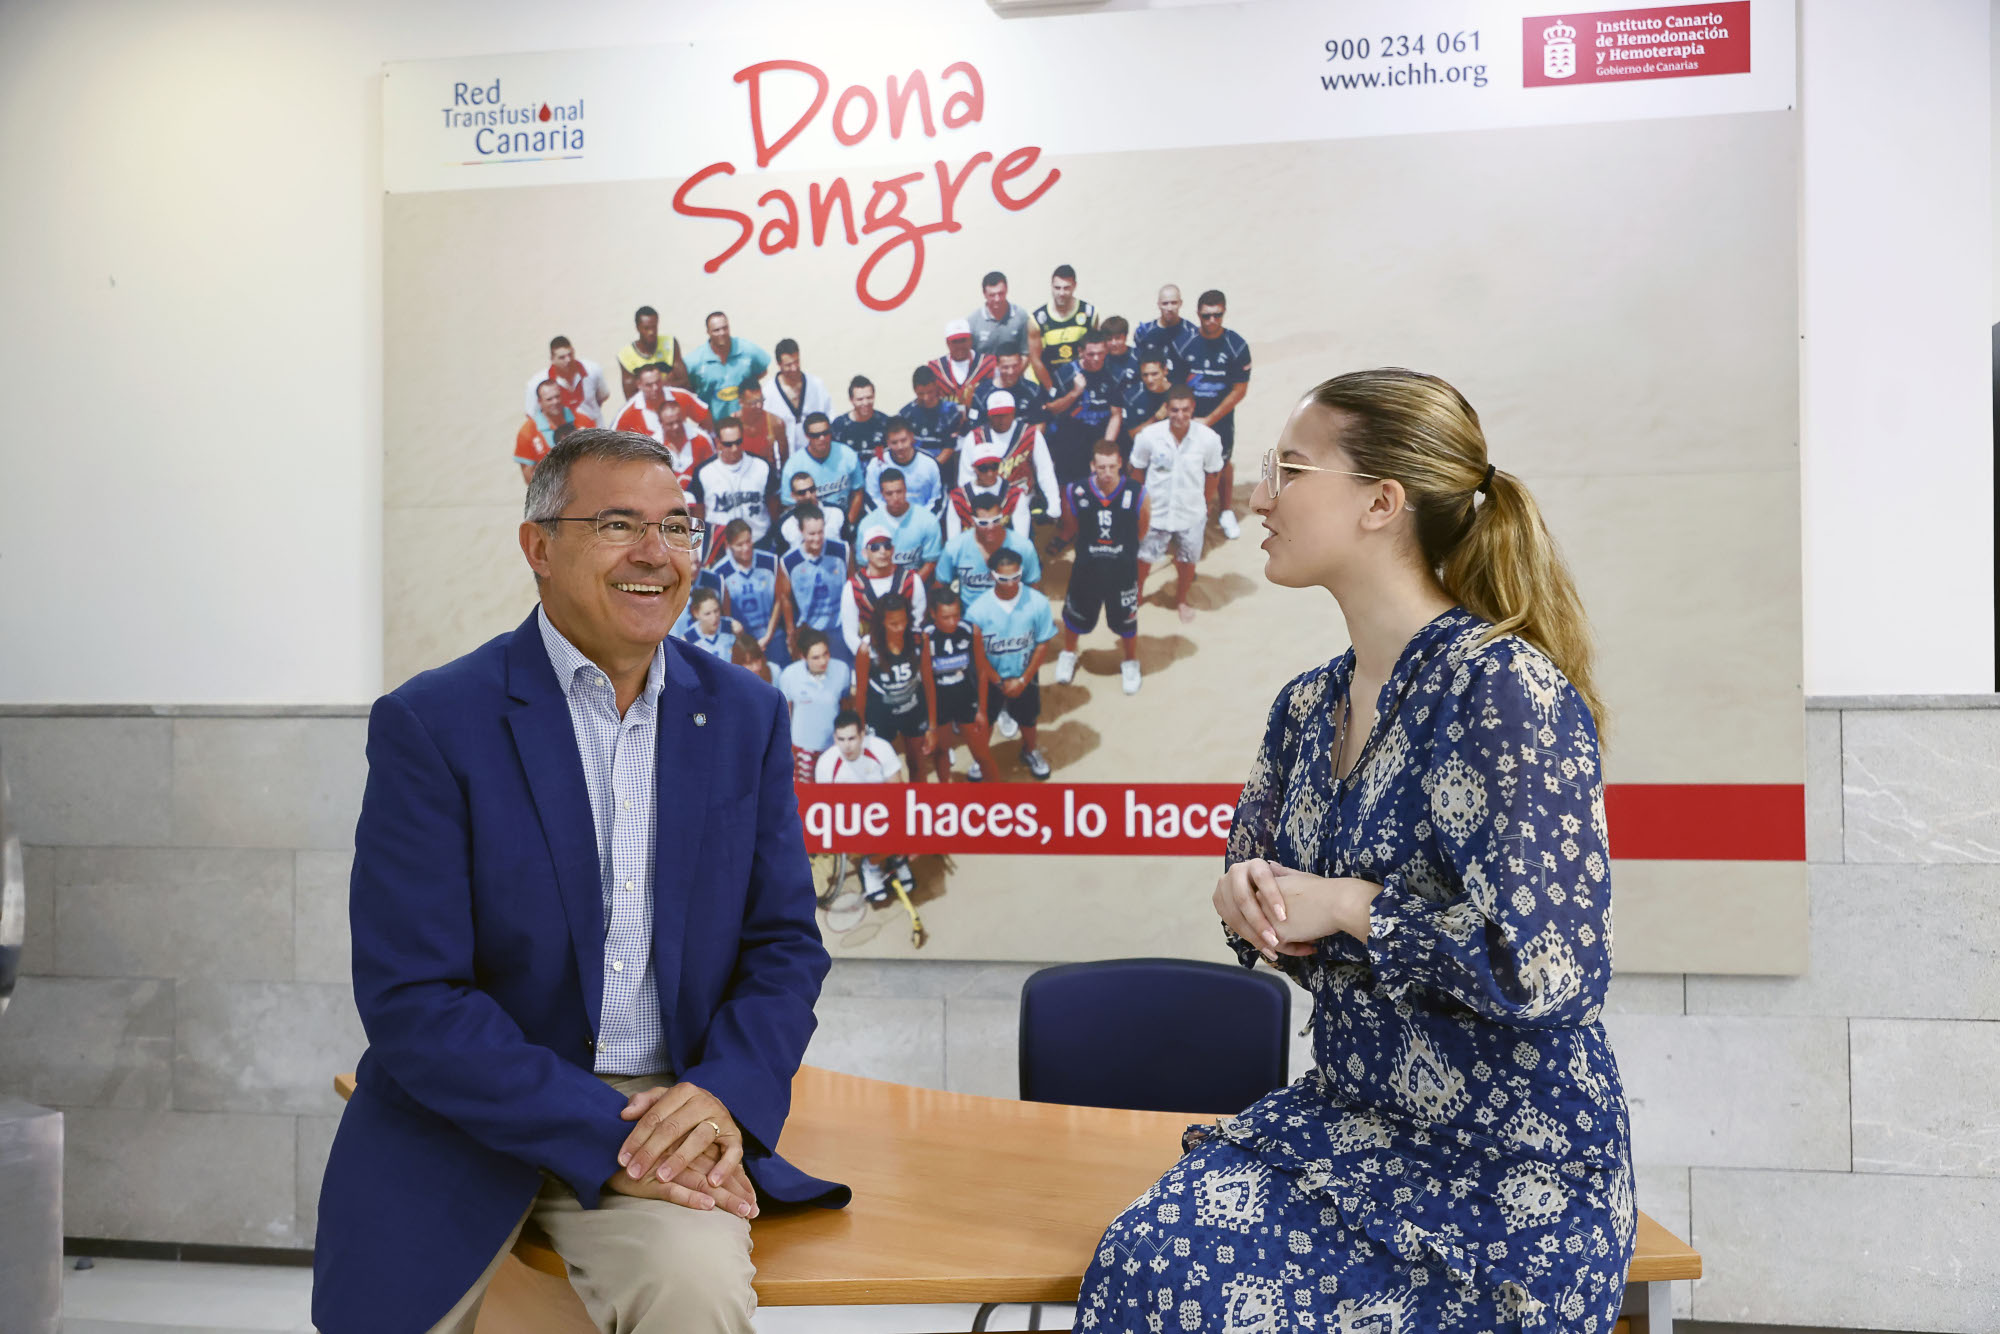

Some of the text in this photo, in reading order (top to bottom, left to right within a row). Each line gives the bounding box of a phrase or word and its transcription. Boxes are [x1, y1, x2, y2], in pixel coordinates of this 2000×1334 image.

[1596, 12, 1723, 33] Instituto Canario
[1325, 30, 1480, 62] 900 234 061
[1595, 26, 1729, 48] de Hemodonación
[1596, 42, 1705, 64] y Hemoterapia
[1321, 62, 1488, 91] www.ichh.org
[1596, 60, 1699, 76] Gobierno de Canarias
[454, 78, 501, 106] Red
[733, 60, 984, 168] Dona
[476, 125, 584, 155] Canaria
[672, 146, 1061, 312] Sangre
[891, 662, 912, 682] 15
[805, 802, 890, 849] que
[905, 789, 1052, 845] haces,
[1064, 789, 1107, 838] lo
